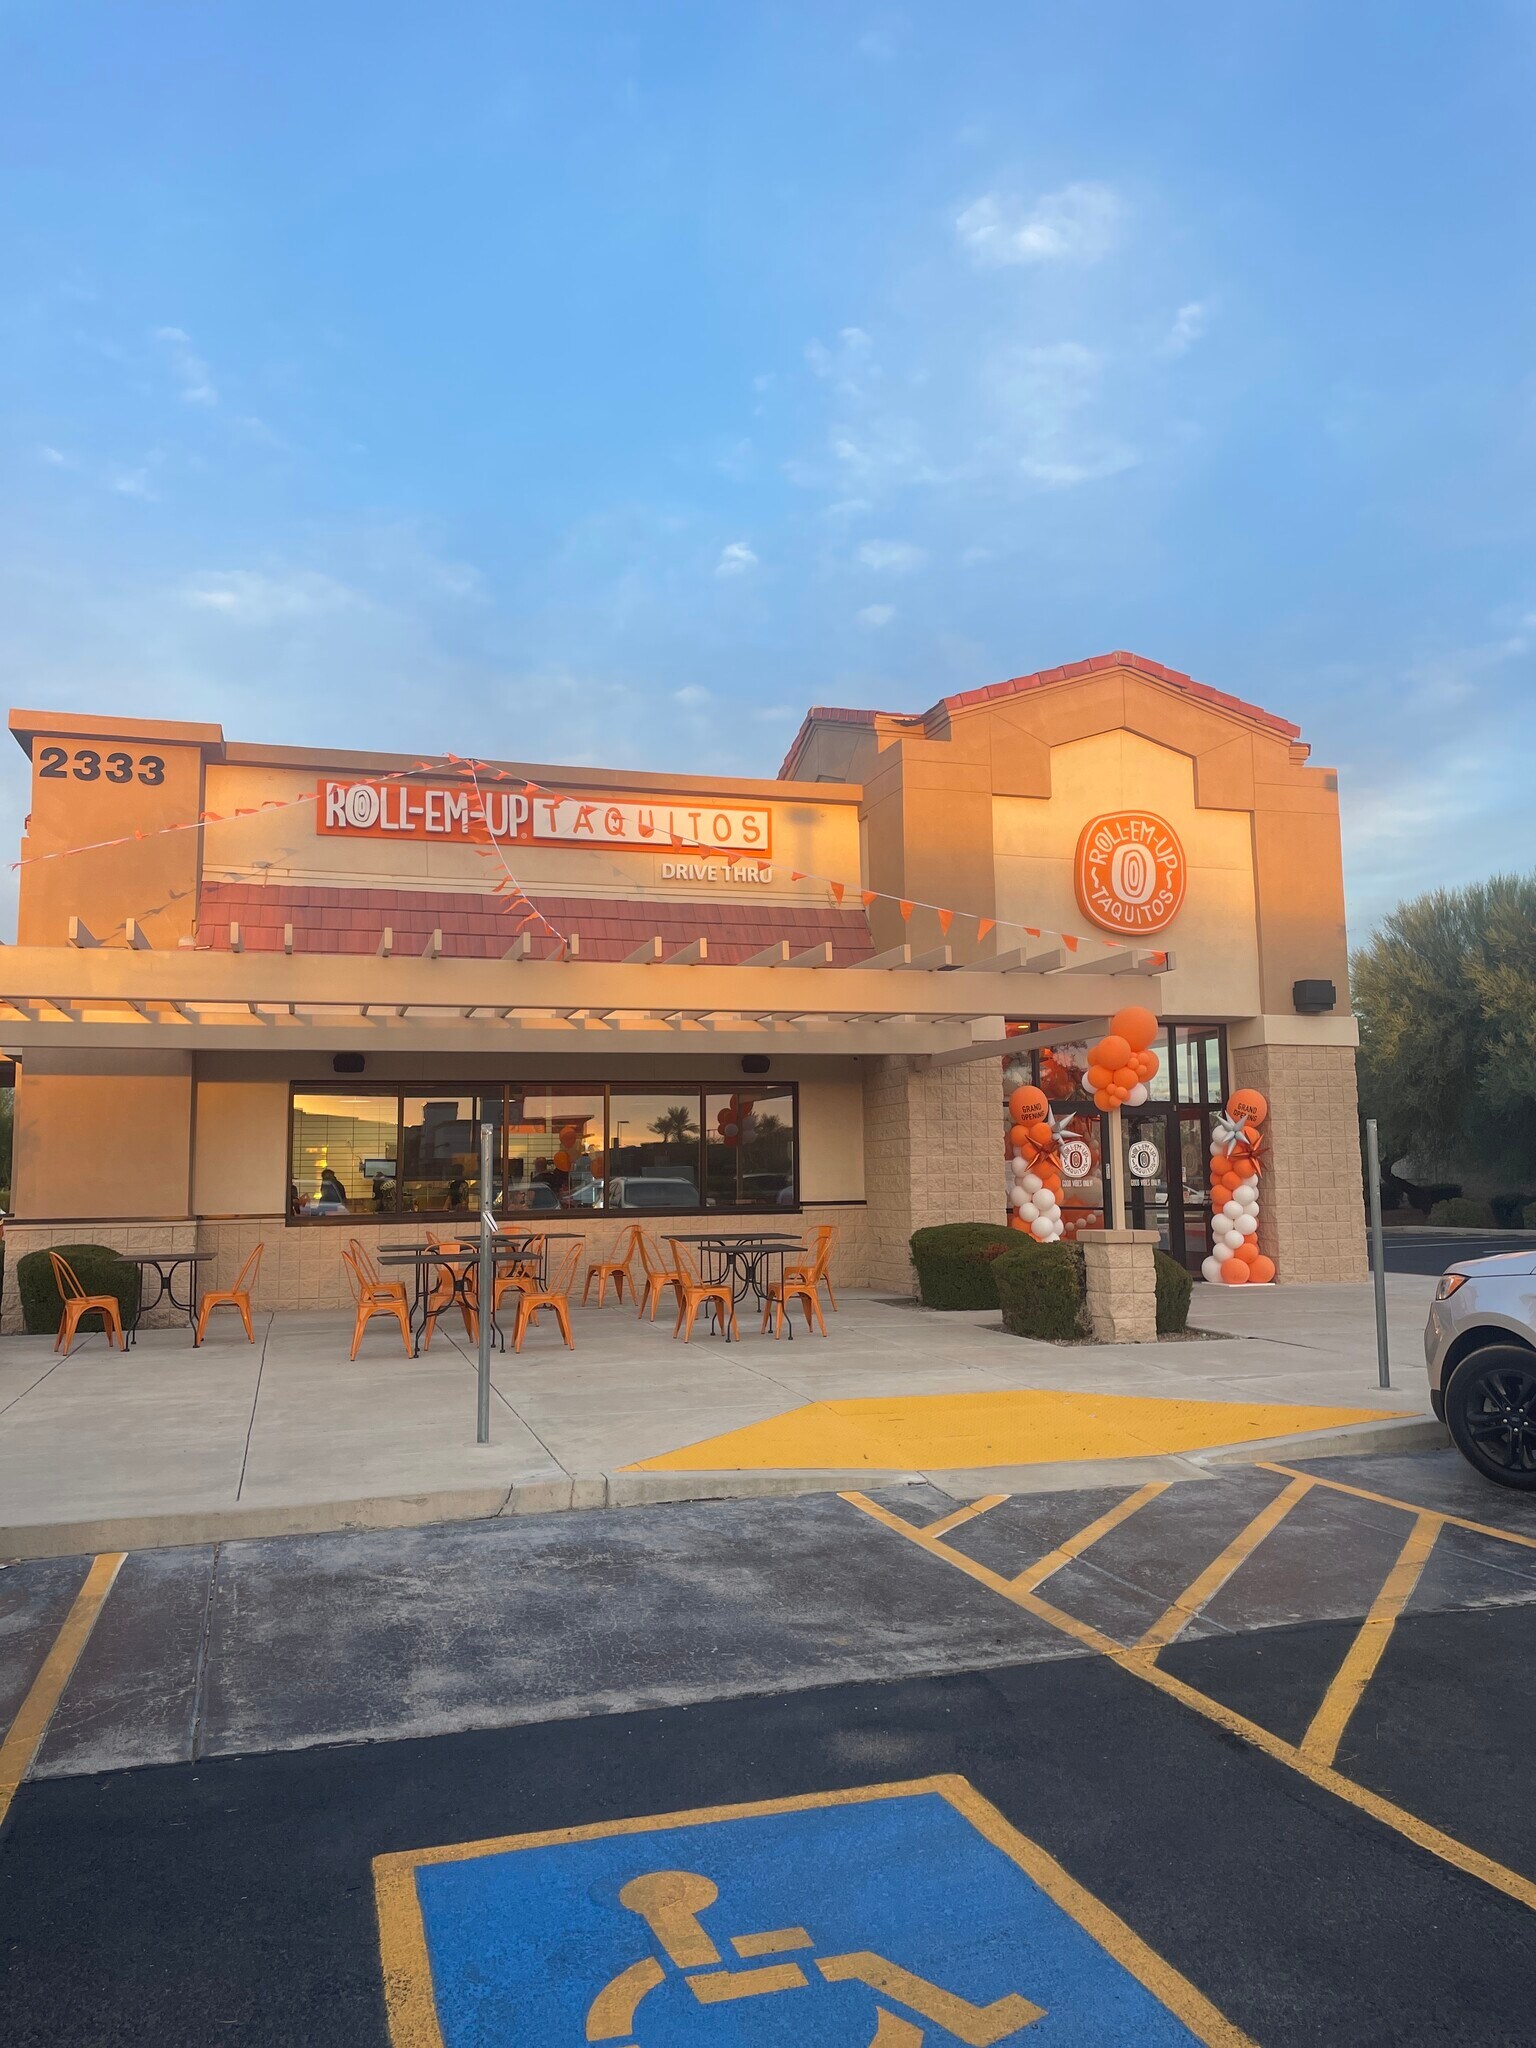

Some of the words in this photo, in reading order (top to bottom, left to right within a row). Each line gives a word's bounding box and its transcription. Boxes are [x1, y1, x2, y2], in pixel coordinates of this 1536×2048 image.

[39, 747, 165, 785] 2333
[326, 782, 529, 837] ROLL-EM-UP
[542, 803, 761, 844] TAQUITOS
[1088, 820, 1178, 869] ROLL-EM-UP
[661, 863, 717, 882] DRIVE
[720, 865, 773, 884] THRU
[1092, 886, 1174, 924] TAQUITOS
[1021, 1103, 1042, 1113] GRAND
[1021, 1110, 1045, 1120] OPENING
[1237, 1103, 1257, 1114] GRAND
